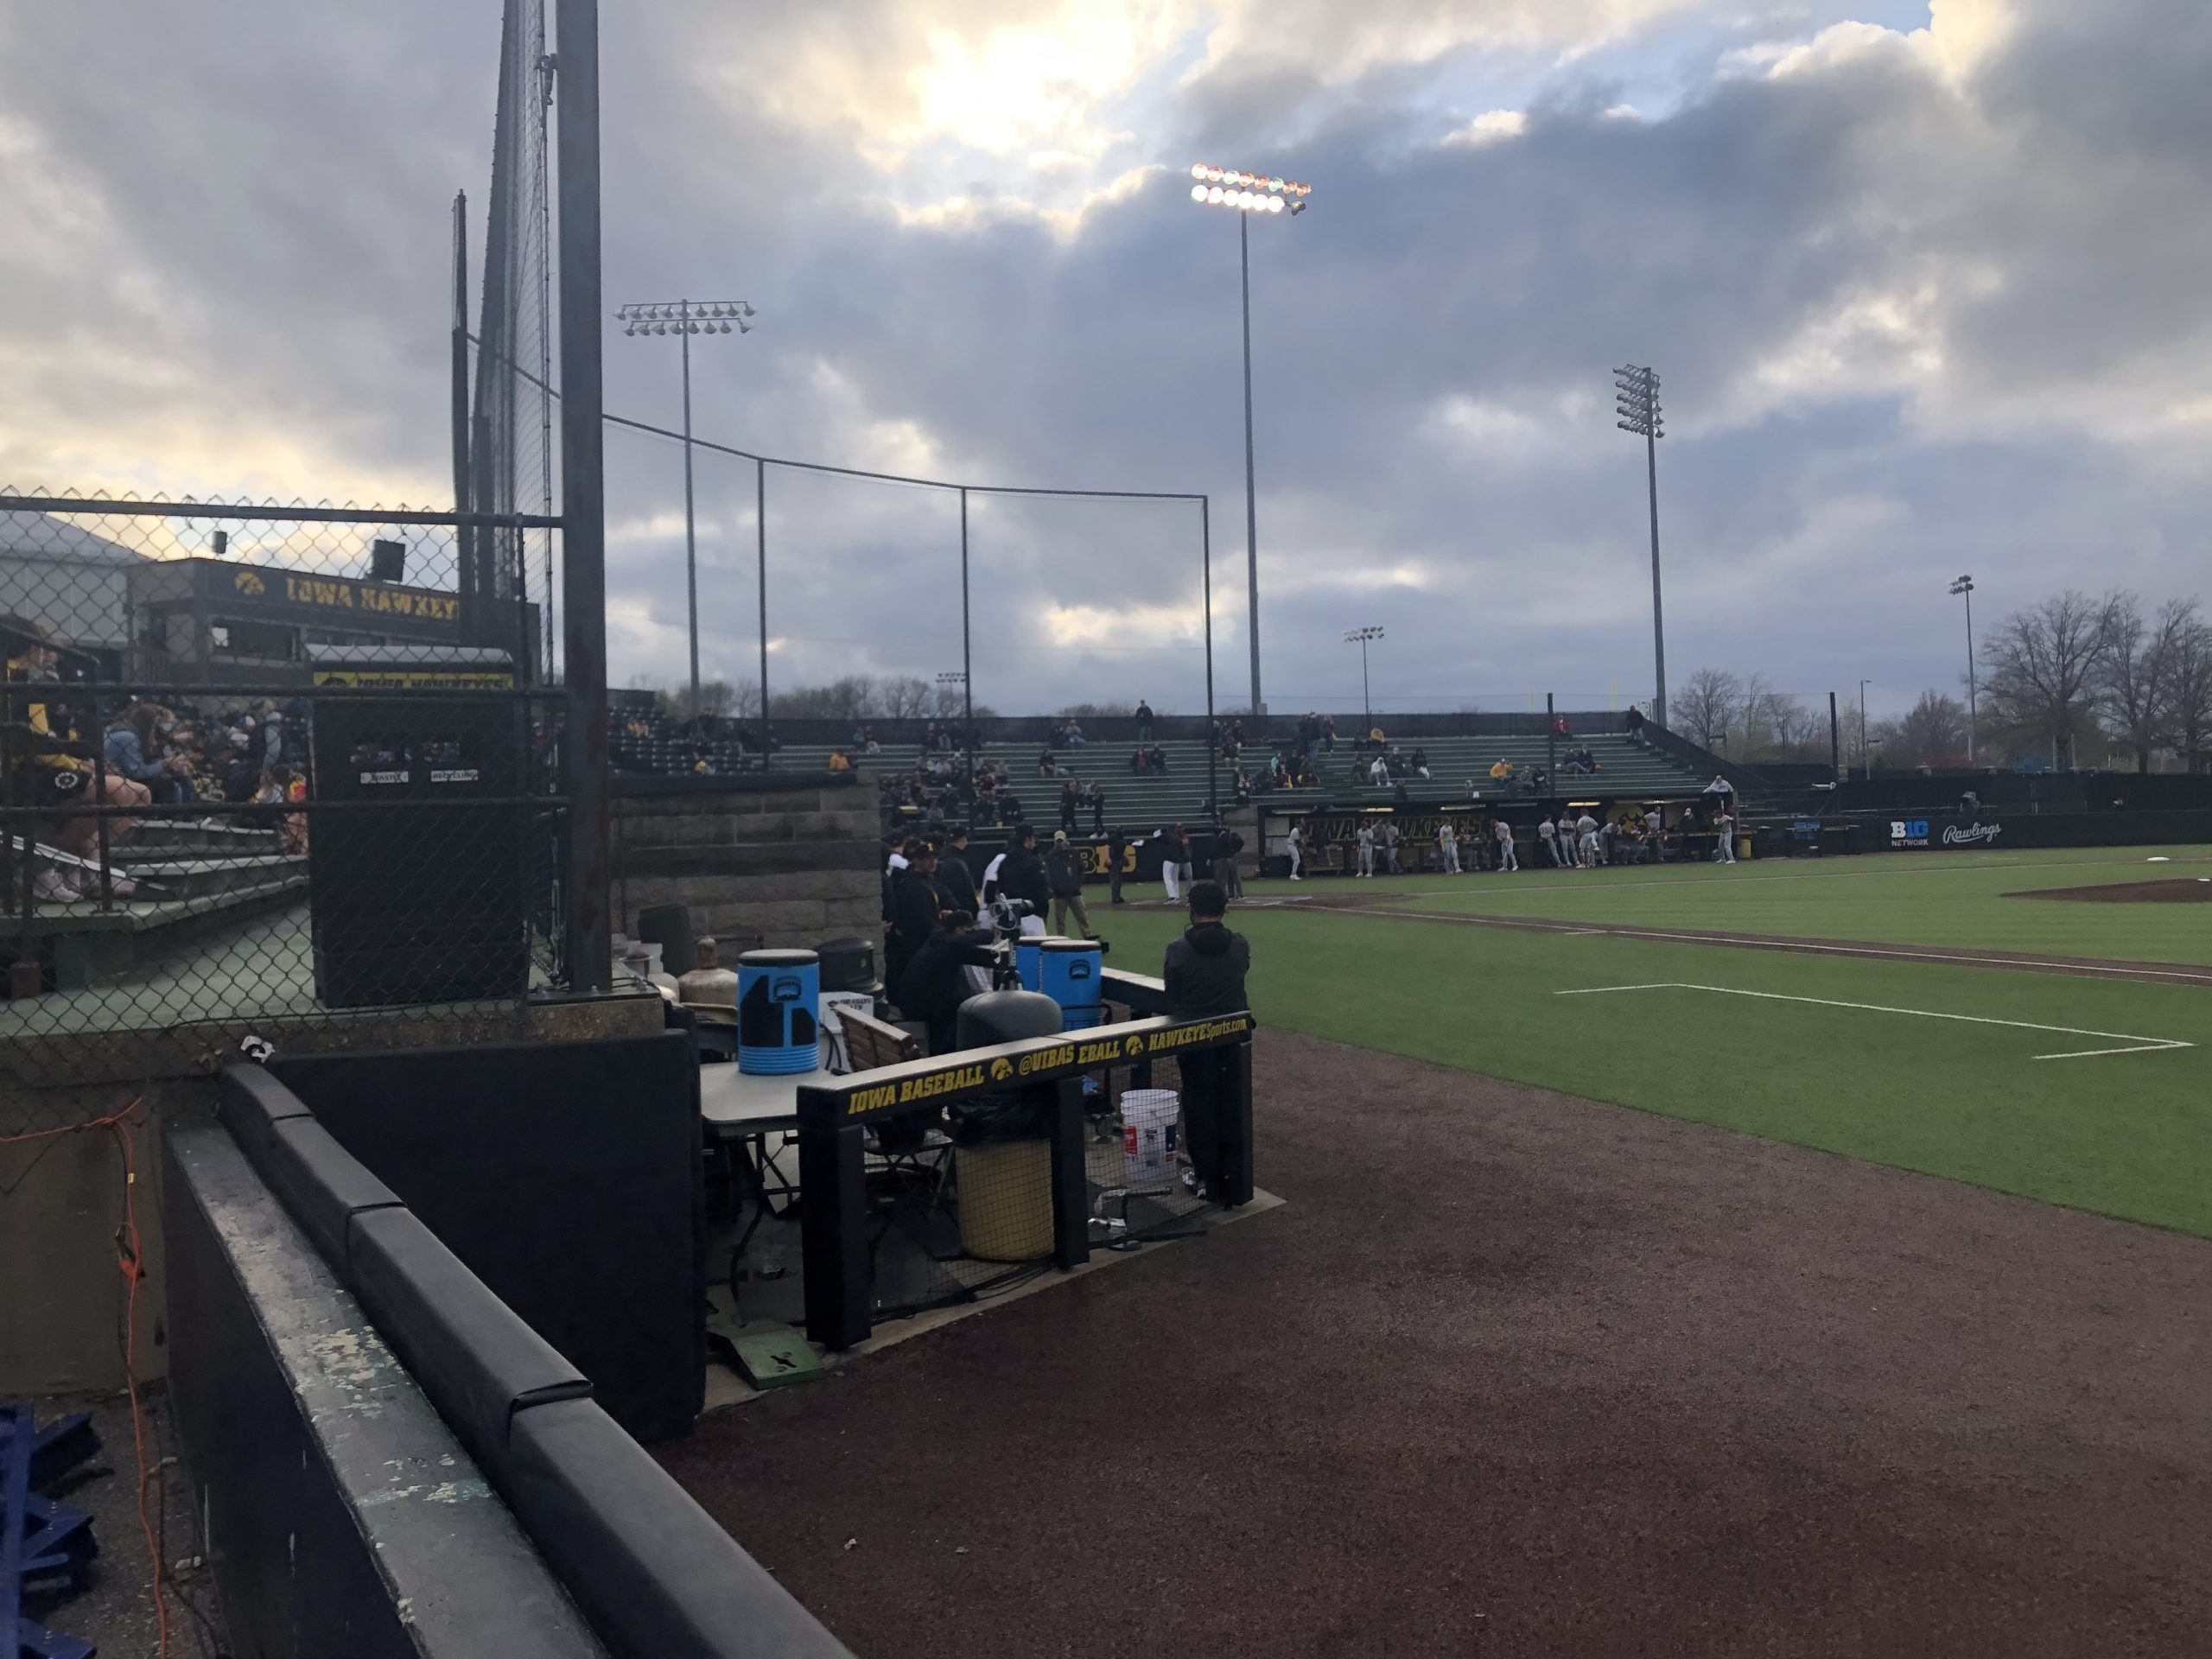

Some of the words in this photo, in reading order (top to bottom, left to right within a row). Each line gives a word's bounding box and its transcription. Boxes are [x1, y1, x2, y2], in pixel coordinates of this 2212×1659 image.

[286, 576, 353, 608] IOWA
[360, 588, 460, 620] HAWKEY
[1891, 838, 1929, 847] NETWORK
[1942, 822, 2001, 844] Rawlings
[848, 1084, 897, 1116] IOWA
[899, 1065, 985, 1103] BASEBALL
